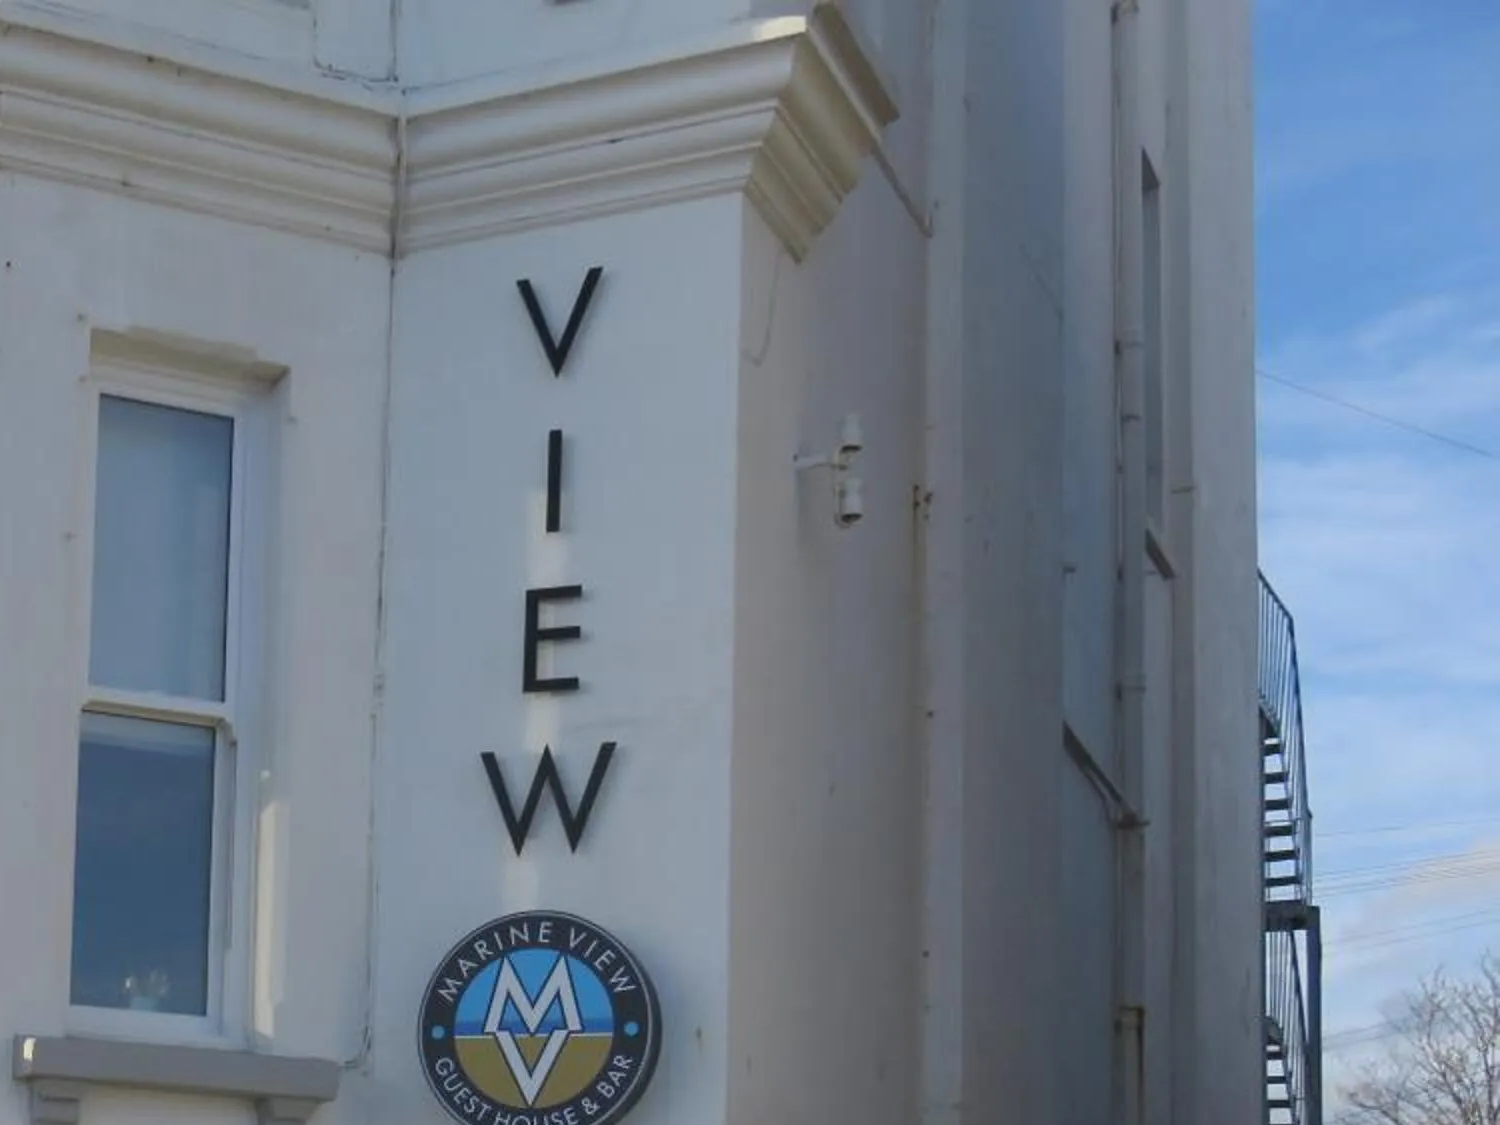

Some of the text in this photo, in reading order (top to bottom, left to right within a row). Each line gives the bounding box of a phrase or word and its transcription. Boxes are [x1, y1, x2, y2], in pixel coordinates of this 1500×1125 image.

[480, 266, 617, 857] VIEW
[438, 921, 637, 1002] MARINE VIEW
[435, 1056, 492, 1122] GUEST
[581, 1098, 600, 1115] &
[597, 1055, 633, 1099] BAR
